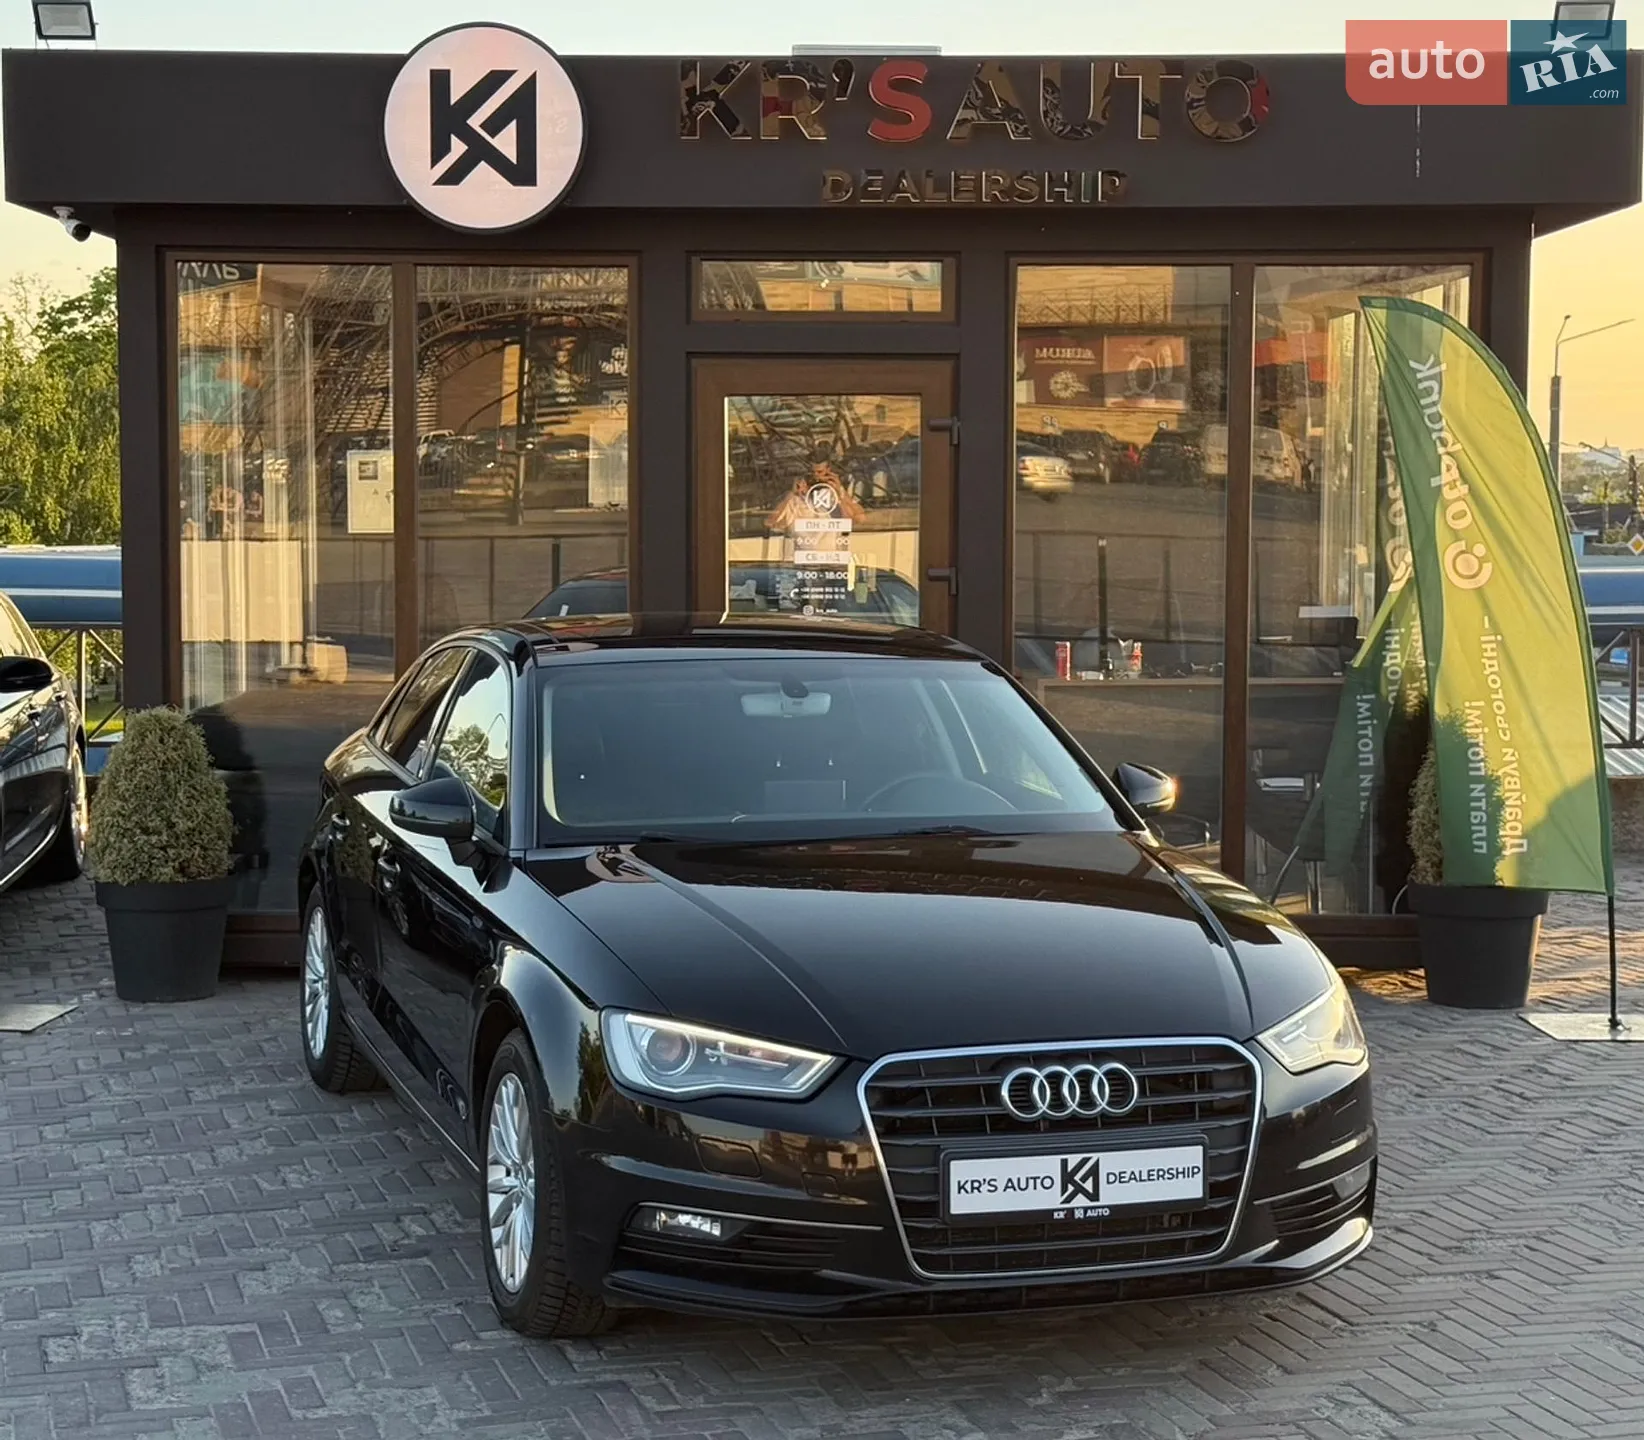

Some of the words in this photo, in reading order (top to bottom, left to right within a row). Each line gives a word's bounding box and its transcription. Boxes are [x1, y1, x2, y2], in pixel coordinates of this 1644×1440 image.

[679, 58, 932, 143] KR'S
[945, 58, 1271, 143] AUTO
[821, 167, 1128, 204] DEALERSHIP
[956, 1178, 998, 1194] KR'S
[1002, 1175, 1055, 1192] AUTO
[1105, 1165, 1201, 1186] DEALERSHIP
[1086, 1207, 1110, 1217] AUTO
